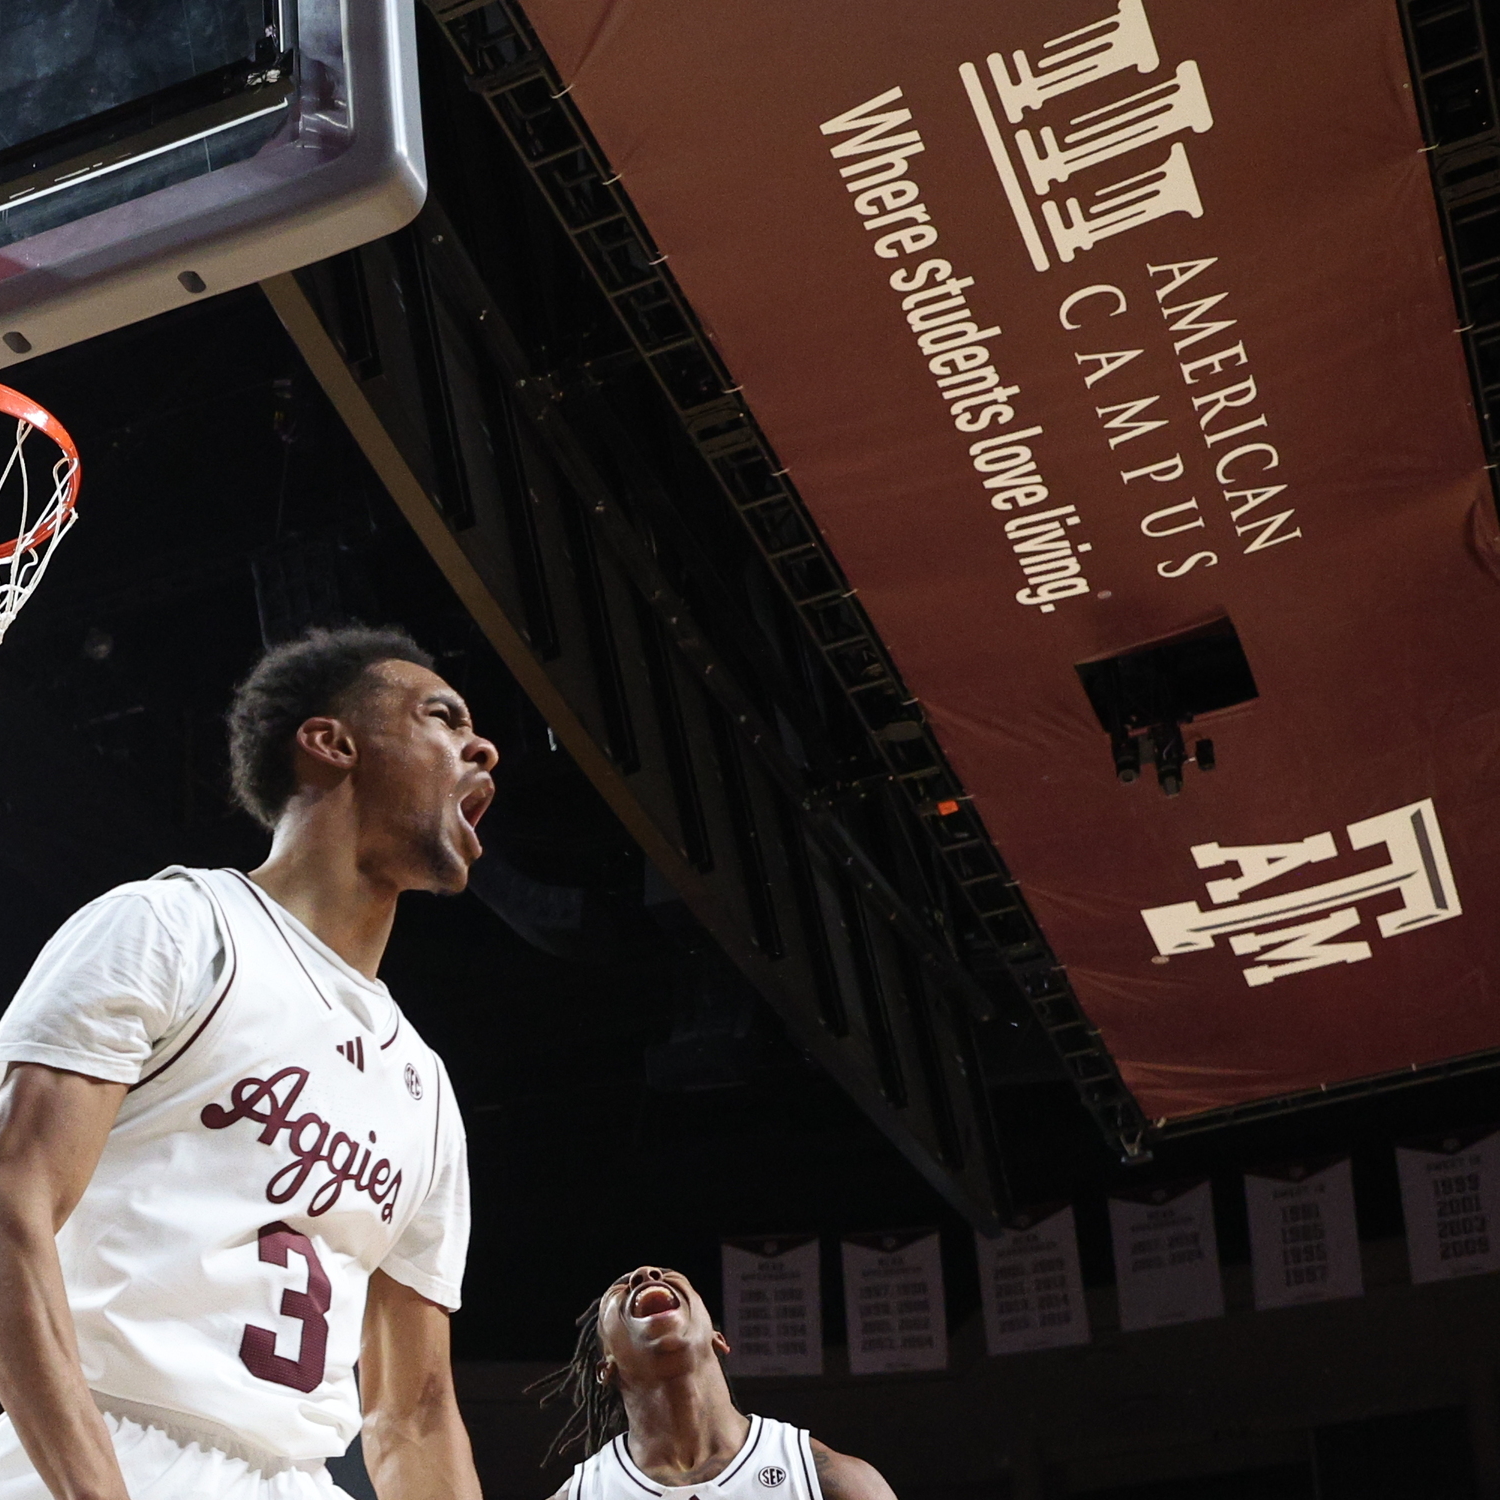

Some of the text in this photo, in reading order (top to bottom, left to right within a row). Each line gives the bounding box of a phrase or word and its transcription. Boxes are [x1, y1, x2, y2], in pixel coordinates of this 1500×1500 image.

[819, 86, 1092, 613] Where students love living.
[1058, 283, 1218, 578] CAMPUS
[1147, 256, 1302, 554] AMERICAN
[200, 1066, 402, 1224] Aggies
[238, 1220, 332, 1394] 3
[760, 1467, 785, 1485] SEC
